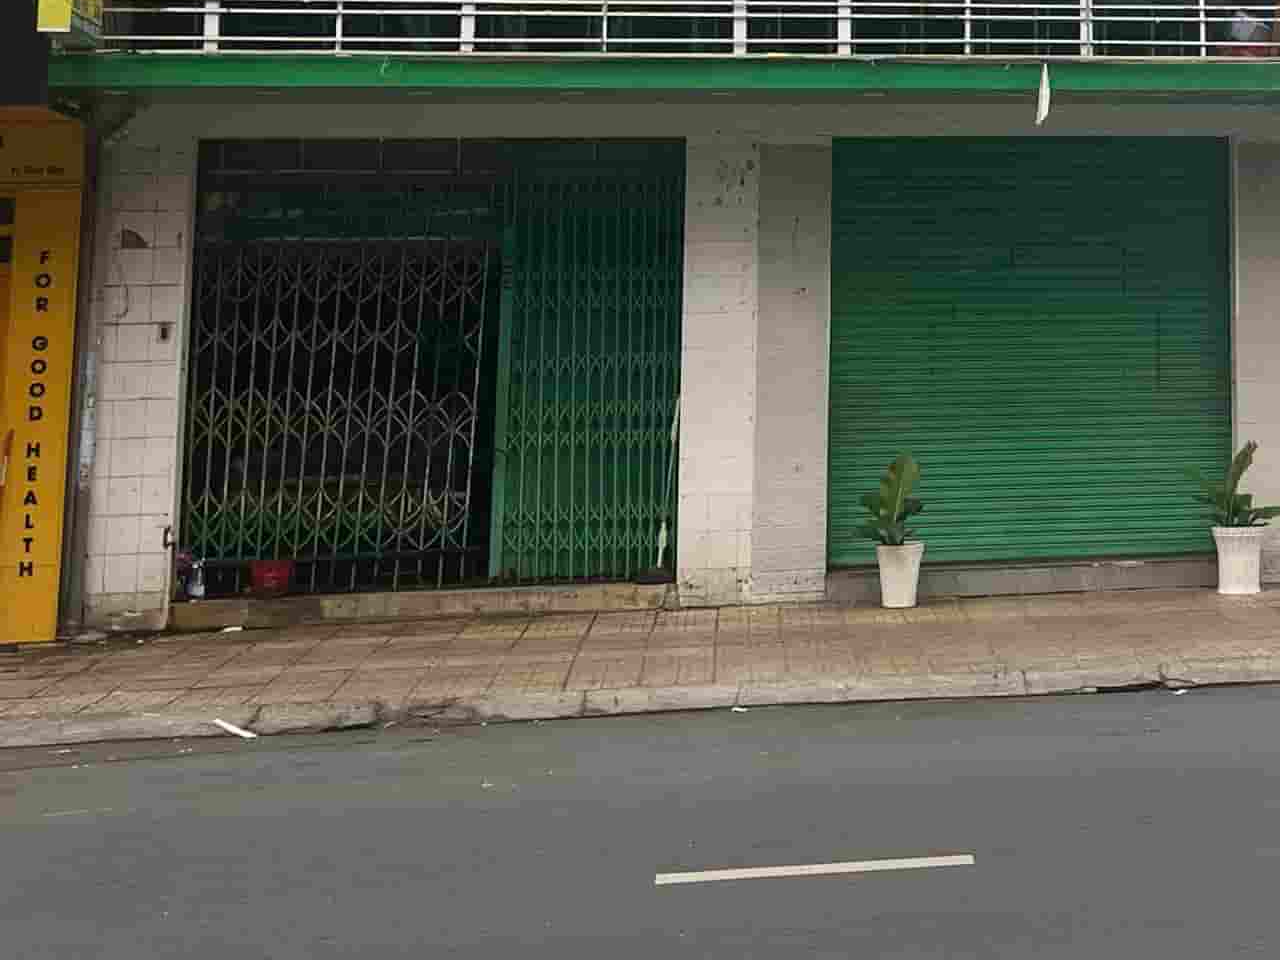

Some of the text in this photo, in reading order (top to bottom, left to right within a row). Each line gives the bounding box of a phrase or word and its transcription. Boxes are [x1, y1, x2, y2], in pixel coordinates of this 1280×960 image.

[18, 249, 51, 577] FOR GOOD HEALTH
